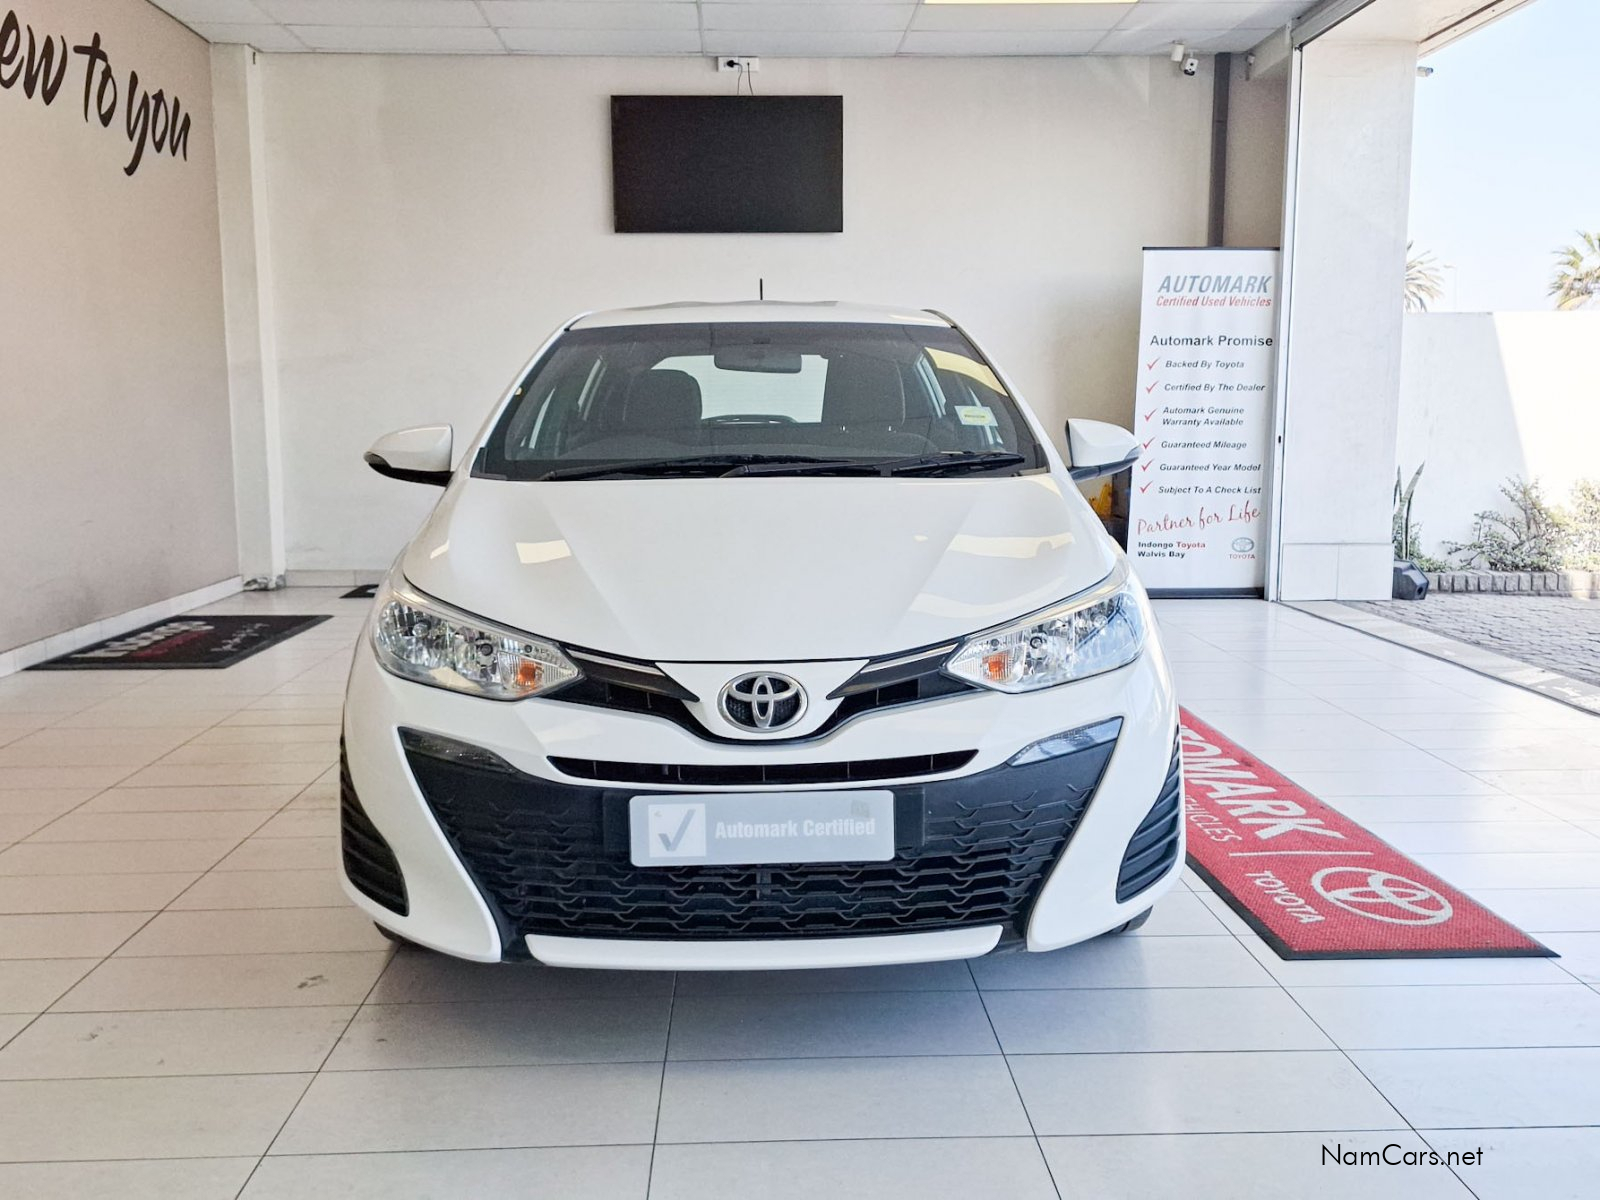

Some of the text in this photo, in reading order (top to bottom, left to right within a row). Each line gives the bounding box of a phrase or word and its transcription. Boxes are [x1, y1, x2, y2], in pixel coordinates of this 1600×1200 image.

[0, 10, 191, 176] ew to you
[1157, 275, 1272, 294] AUTOMARK
[1156, 296, 1272, 307] Certified Used Vehicles
[1150, 335, 1273, 346] Automark Promise
[1165, 360, 1244, 369] Backed By Toyota
[1203, 384, 1215, 393] By
[1162, 418, 1244, 427] Warranty Available
[1160, 441, 1247, 450] Guaranteed Mileage
[1159, 464, 1262, 472] Guaranteed Year Model
[1158, 486, 1262, 496] Subject To A Check List
[1137, 500, 1262, 535] Partner for Life
[1138, 541, 1206, 550] Indongo Toyota
[1137, 550, 1186, 559] Walvis Bay
[1181, 725, 1348, 840] OMARK
[714, 818, 876, 839] Automark Certified
[1245, 870, 1326, 924] TOYOTA
